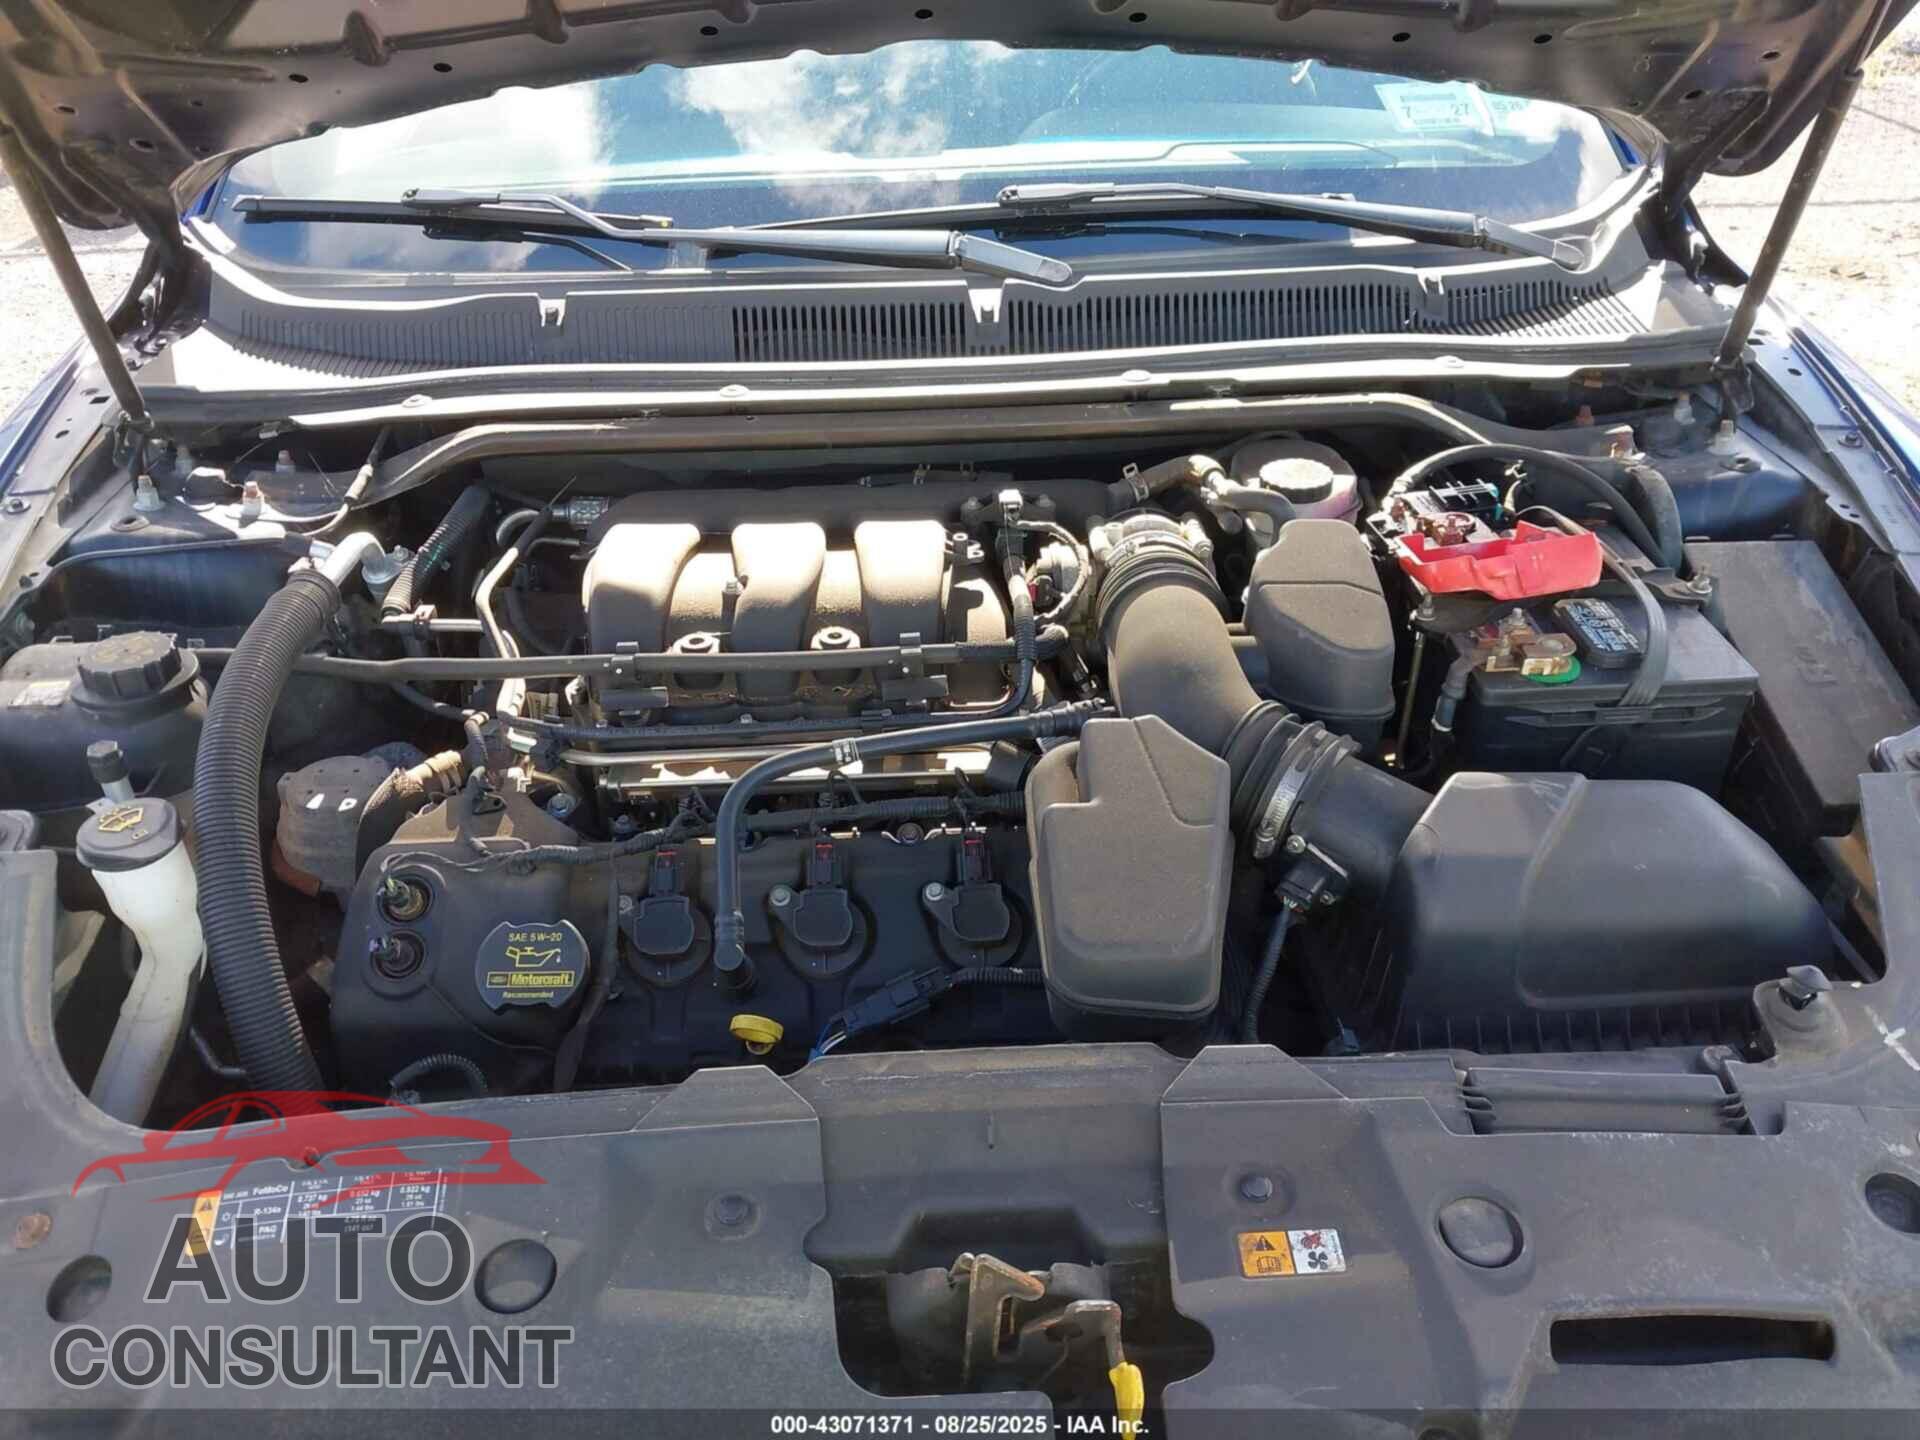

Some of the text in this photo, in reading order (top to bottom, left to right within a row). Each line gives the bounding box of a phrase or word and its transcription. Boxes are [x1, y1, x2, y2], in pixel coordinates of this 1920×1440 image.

[508, 932, 563, 942] SAE 5W-20
[511, 973, 570, 985] Motorcraft
